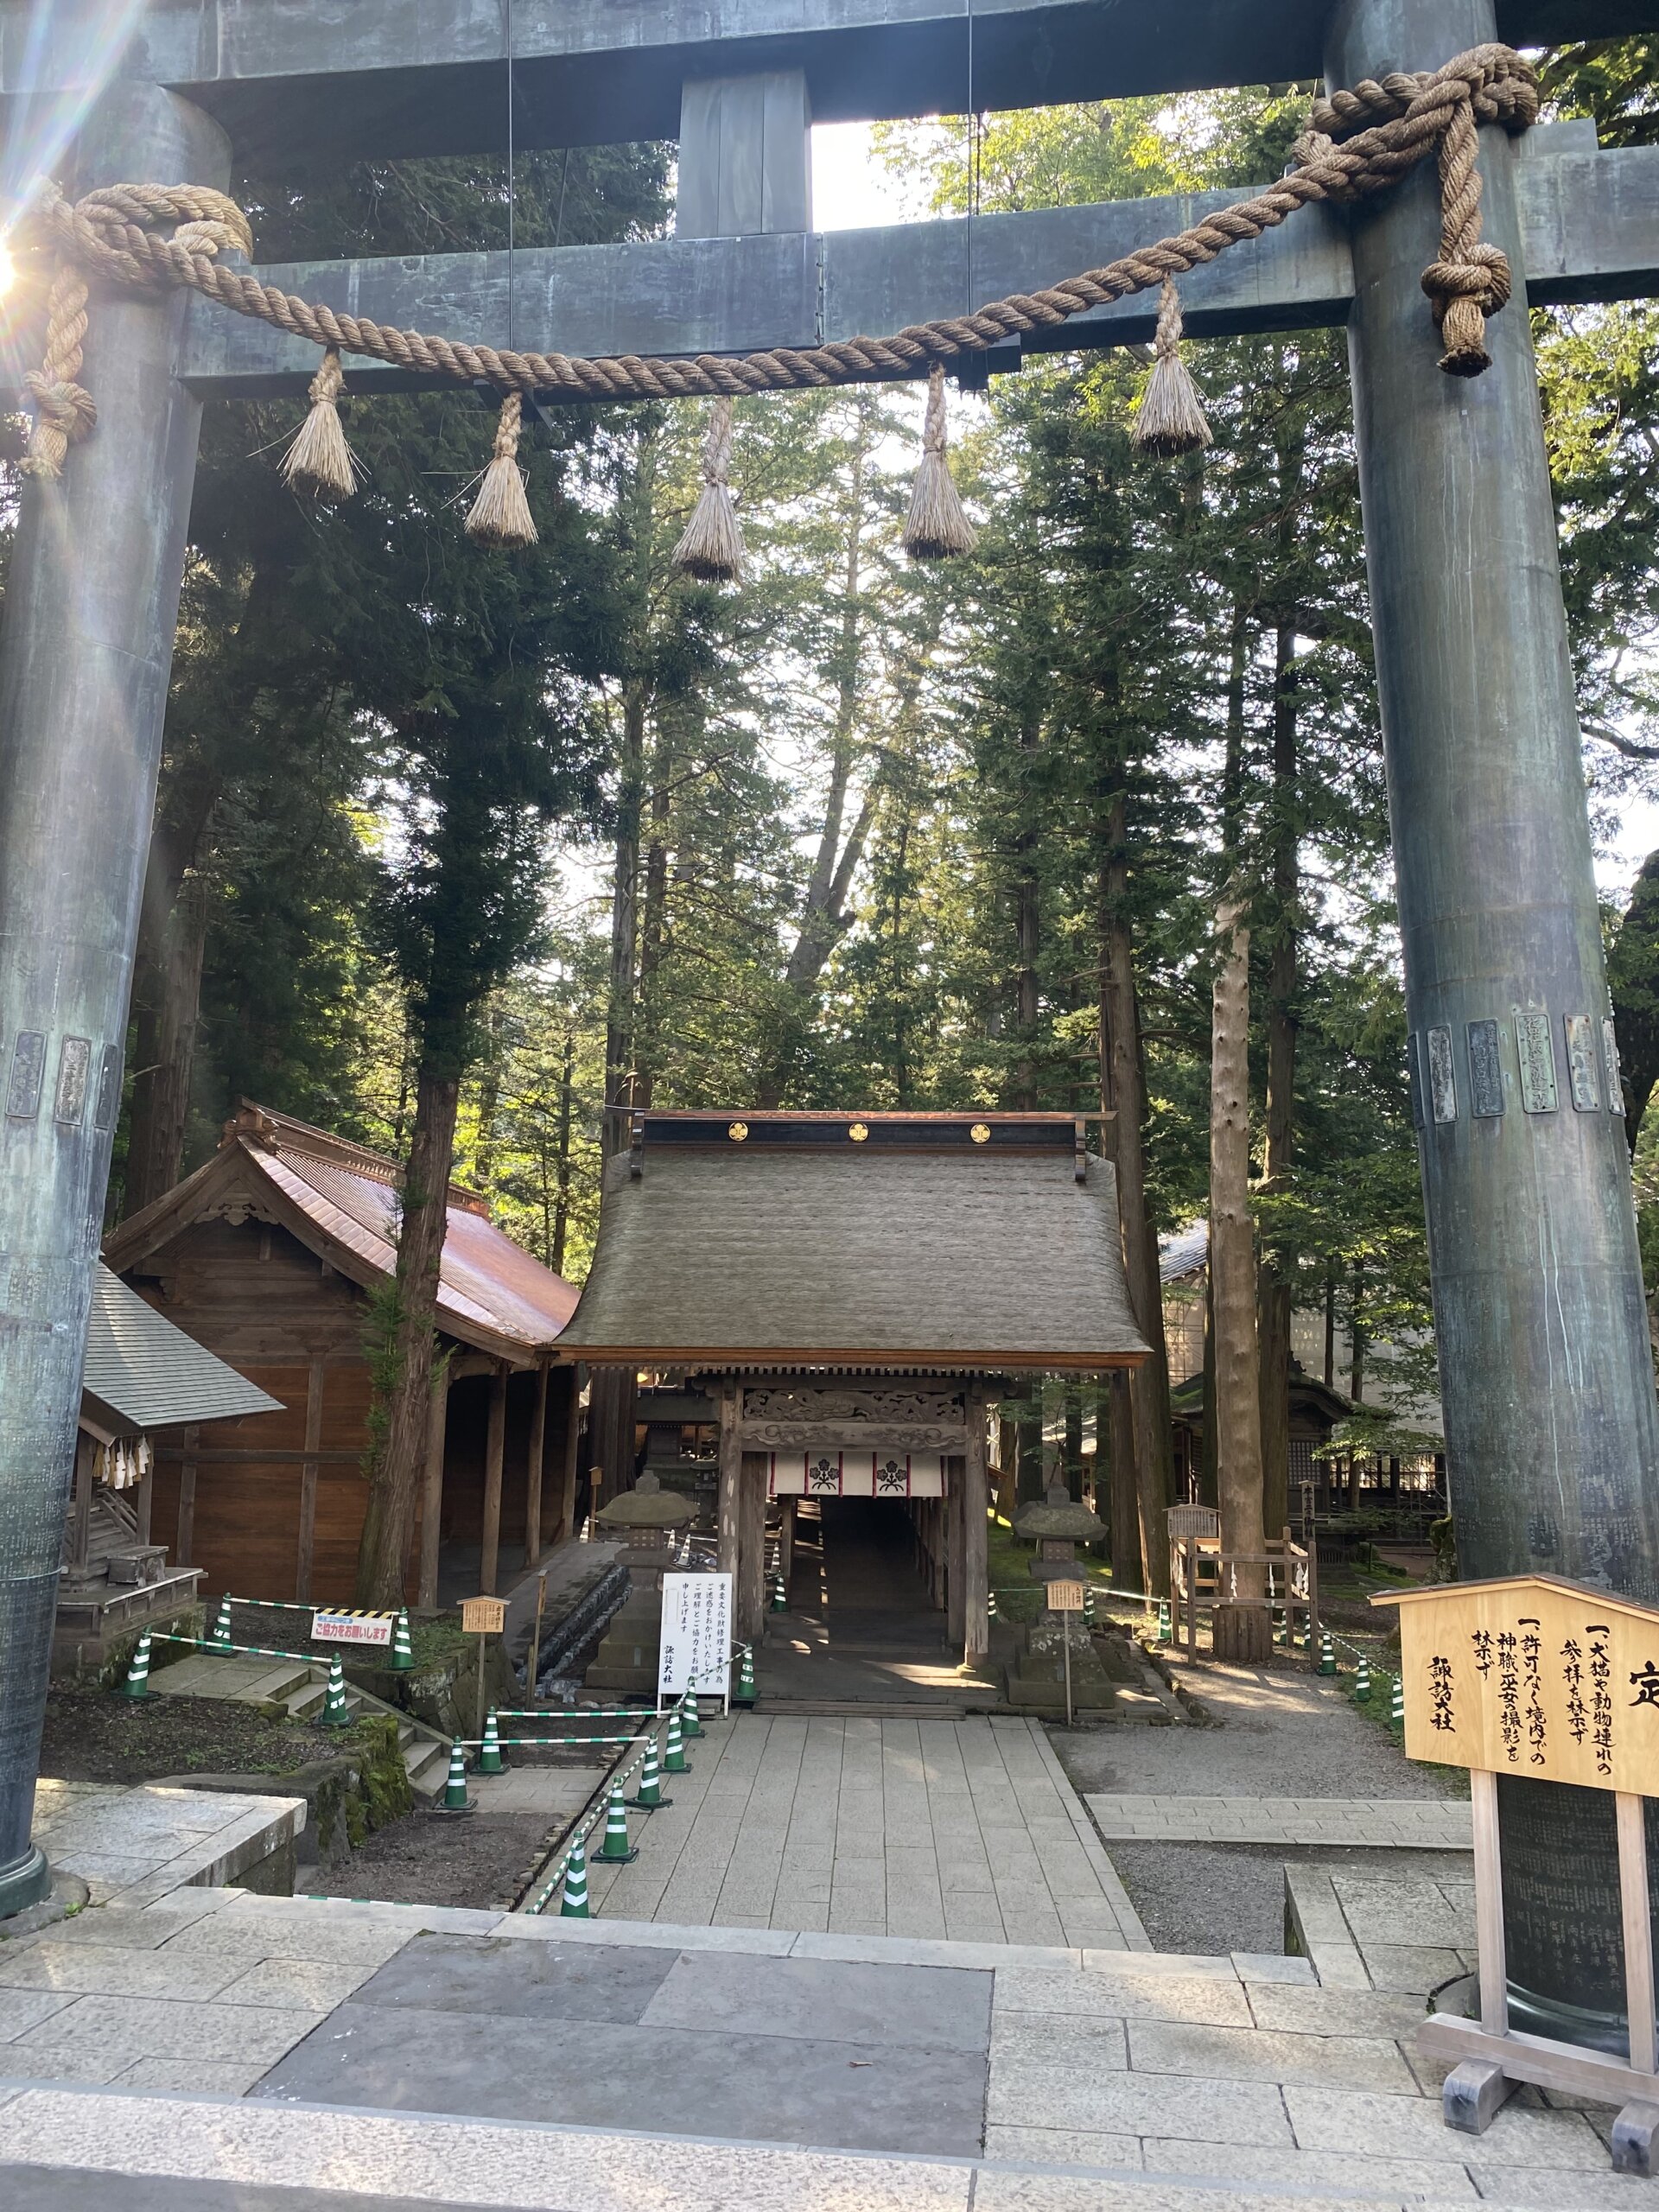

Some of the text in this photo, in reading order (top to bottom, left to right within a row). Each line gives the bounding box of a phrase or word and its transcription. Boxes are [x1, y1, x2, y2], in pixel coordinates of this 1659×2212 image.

[315, 1623, 387, 1640] ご協力をお願いします
[664, 1645, 674, 1683] 諏訪大社
[716, 1583, 725, 1684] 重要文化財修理工事の為
[1471, 1630, 1495, 1681] 禁ず
[1427, 1656, 1456, 1733] 諏訪大社
[1496, 1631, 1523, 1763] 神職・巫女の撮影を
[1517, 1618, 1547, 1765] 一、許可なく境内での
[1560, 1639, 1590, 1745] 参拝を禁ず
[1585, 1624, 1617, 1776] 一、犬猫や動物連れの
[1628, 1660, 1659, 1709] 定
